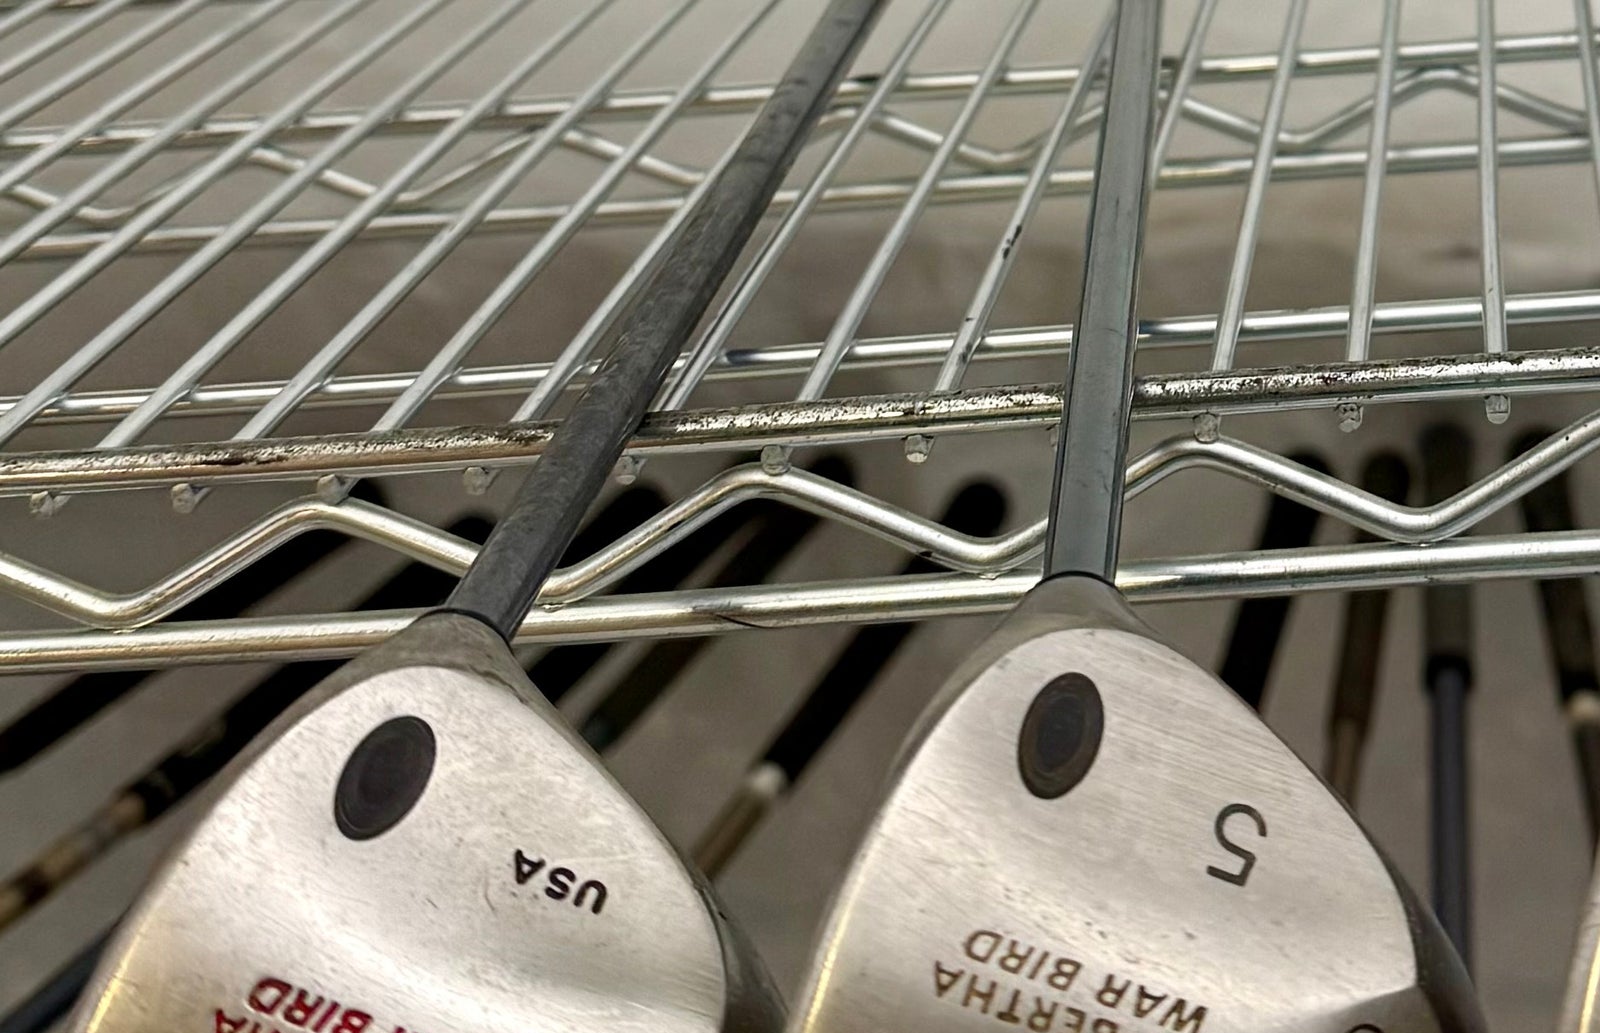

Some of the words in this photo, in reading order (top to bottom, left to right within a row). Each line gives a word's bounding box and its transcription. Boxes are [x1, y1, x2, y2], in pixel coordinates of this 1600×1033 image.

[1206, 803, 1267, 887] 5
[514, 848, 609, 915] USA
[962, 929, 1083, 992] BIRD
